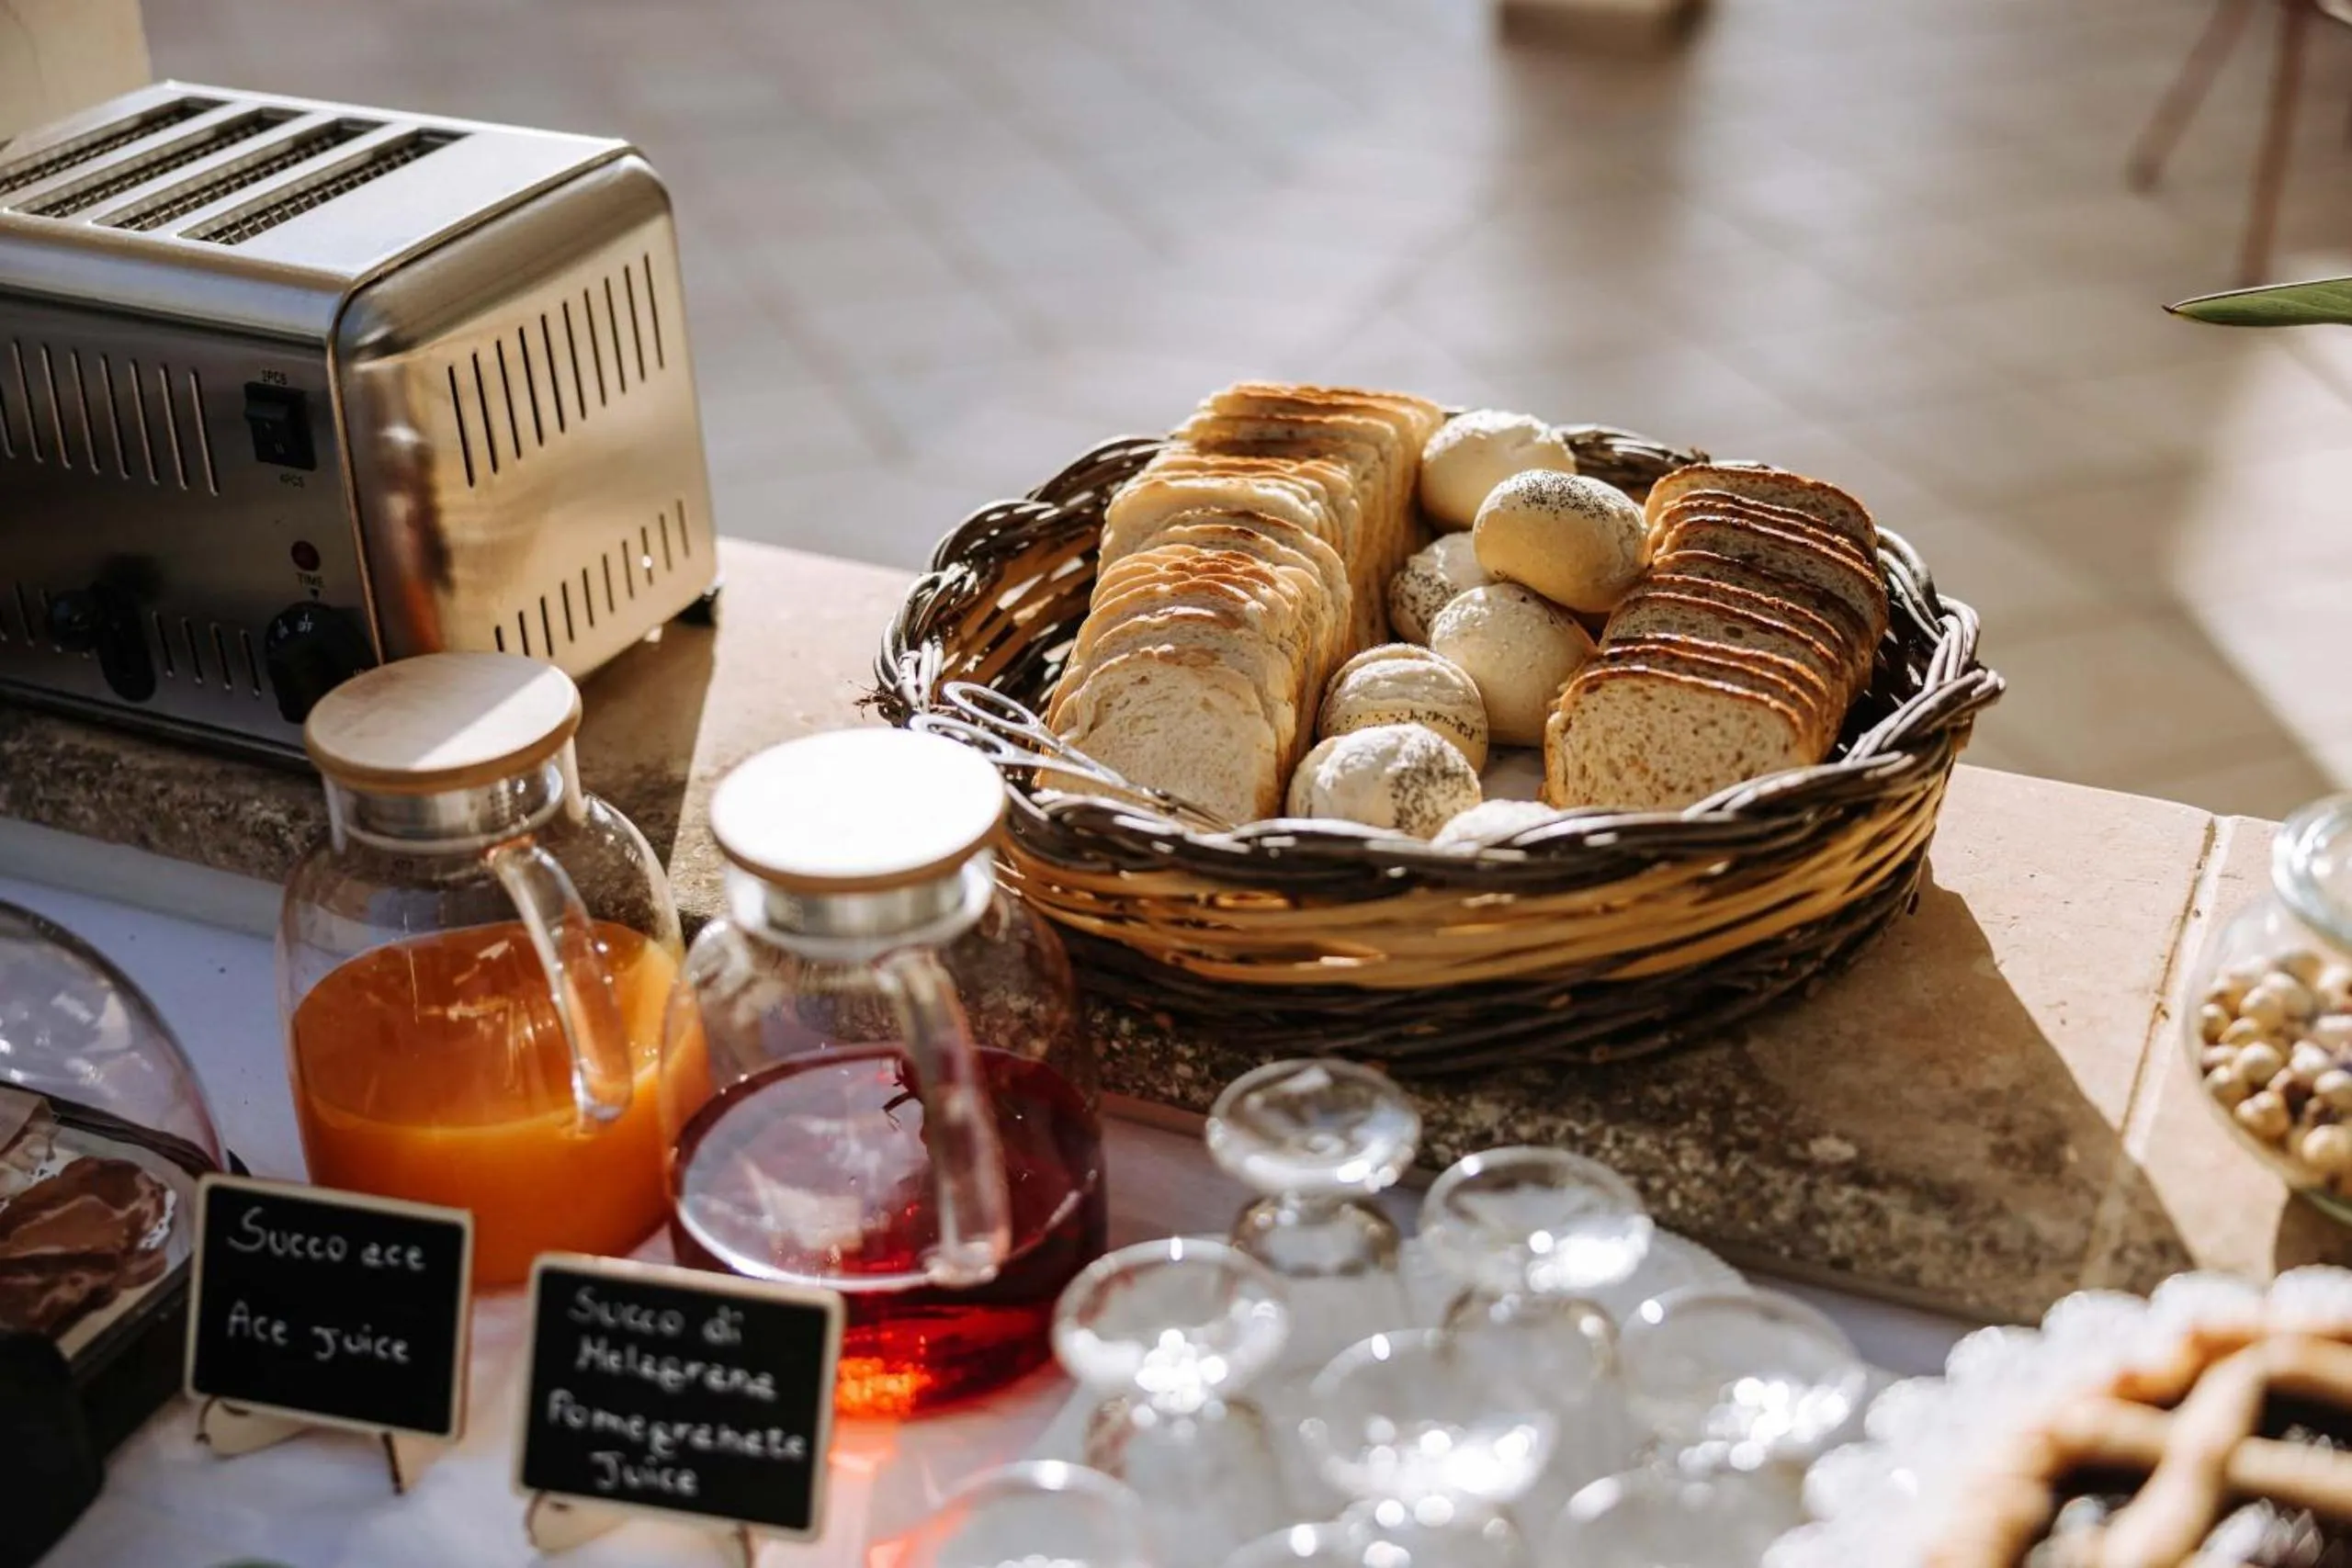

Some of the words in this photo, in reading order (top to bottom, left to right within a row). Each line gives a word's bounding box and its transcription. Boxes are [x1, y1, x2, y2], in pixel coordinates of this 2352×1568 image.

[295, 572, 325, 589] TIME
[228, 1205, 347, 1261] Succo
[227, 1299, 288, 1346] Ace
[568, 1285, 685, 1337] Succo
[702, 1304, 745, 1346] di
[590, 1450, 699, 1497] Juice
